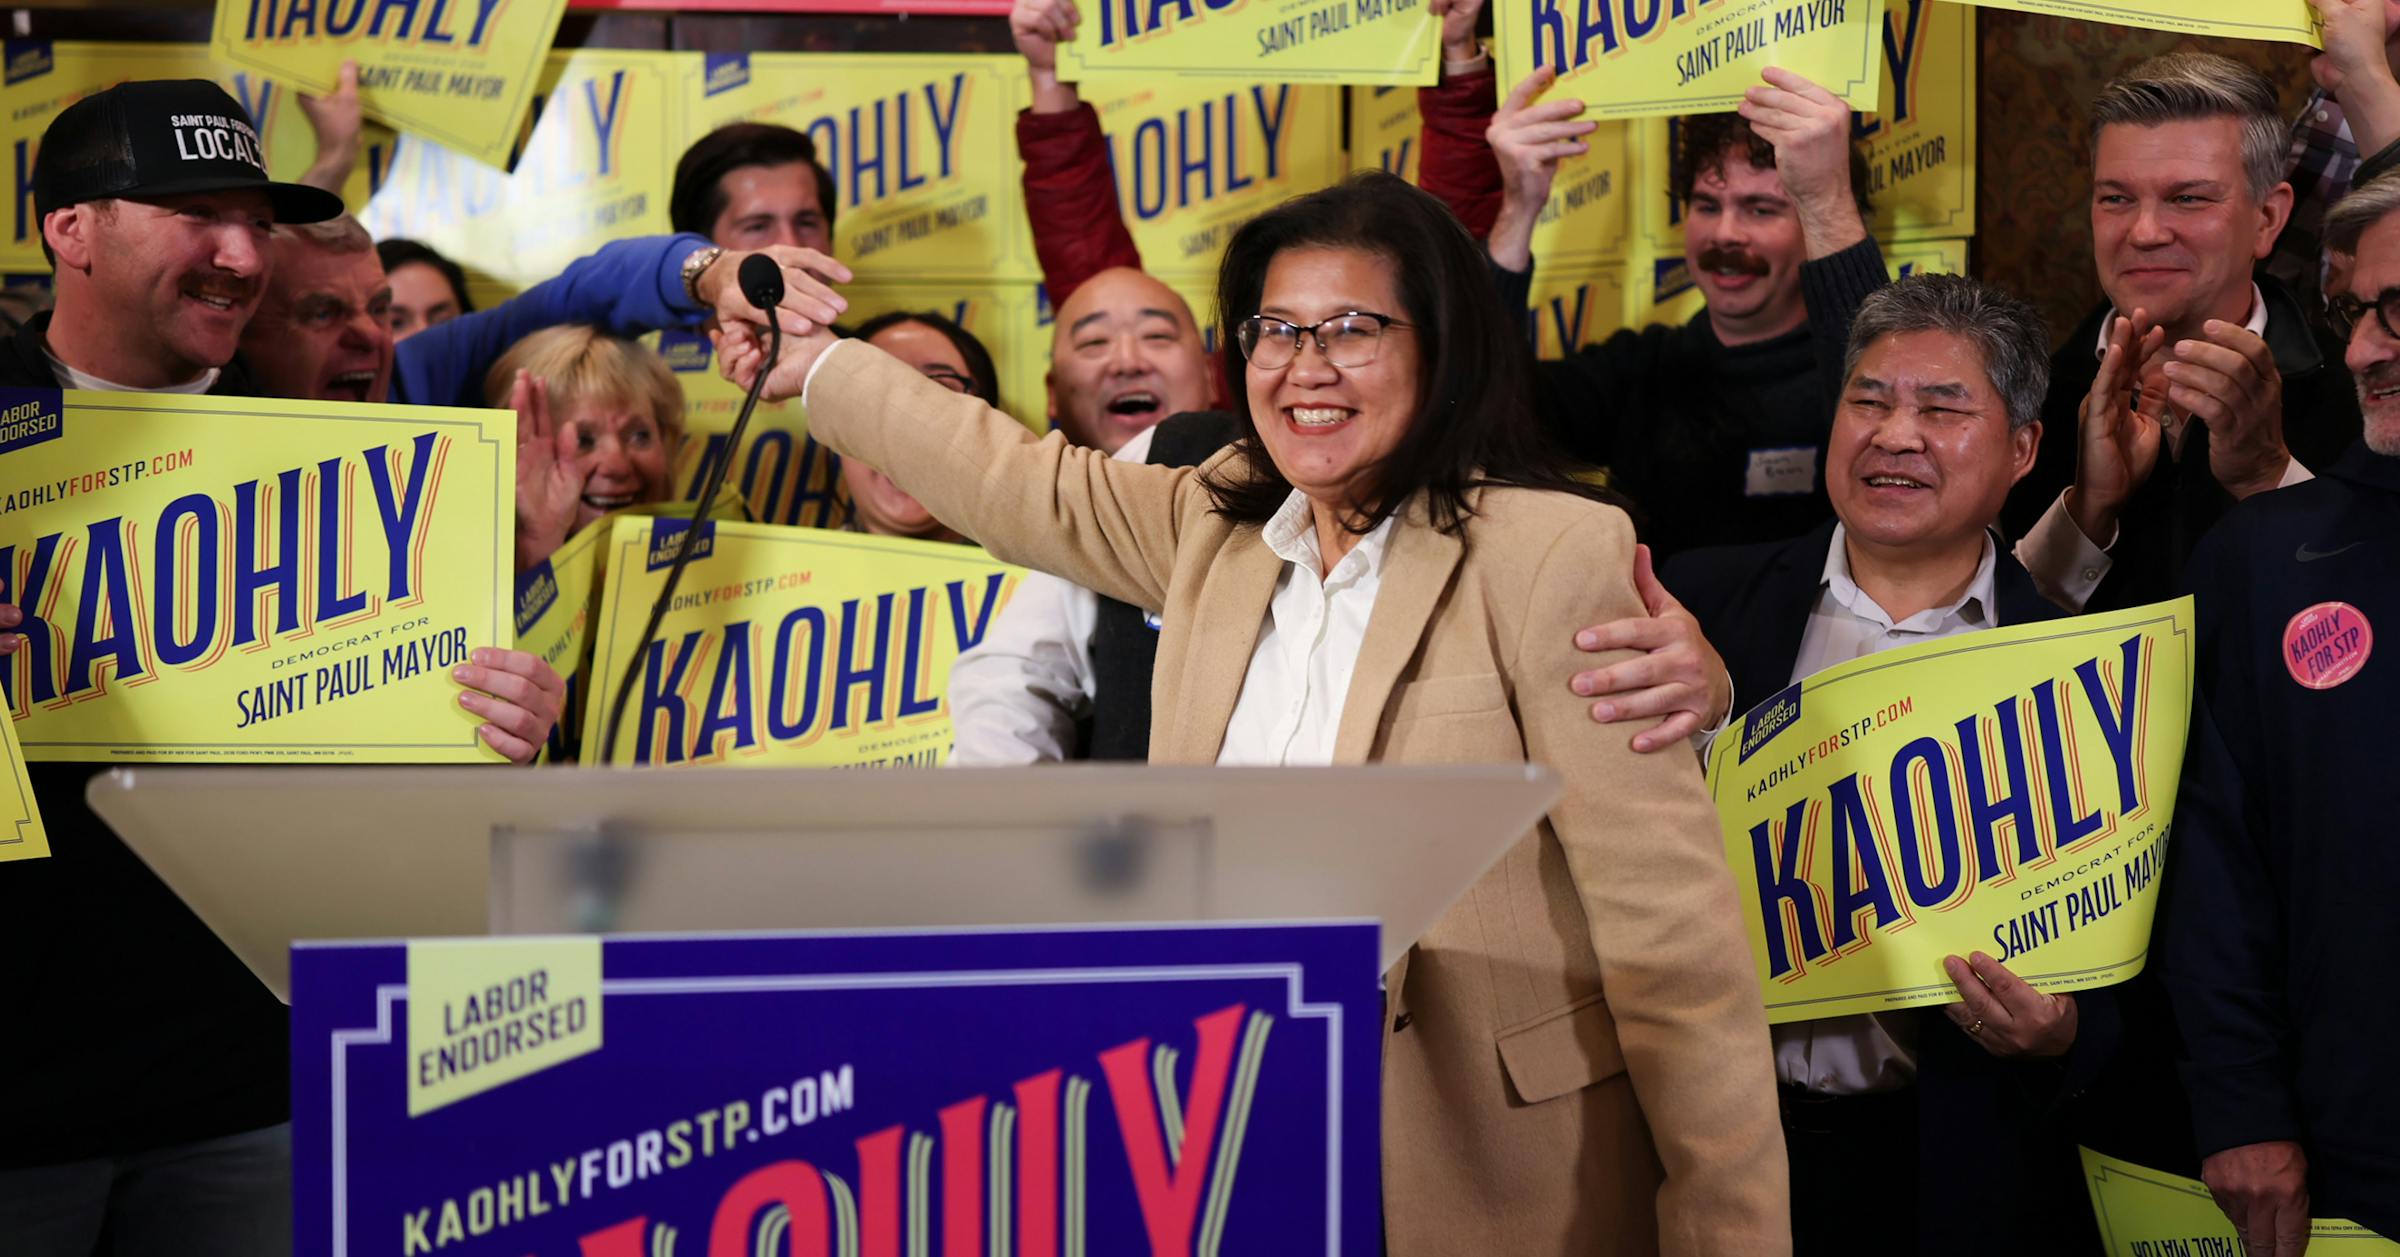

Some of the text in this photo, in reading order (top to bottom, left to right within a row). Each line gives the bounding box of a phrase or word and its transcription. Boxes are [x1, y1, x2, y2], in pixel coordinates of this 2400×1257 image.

[1257, 16, 1305, 57] SAINT
[1310, 3, 1351, 40] PAUL
[1676, 36, 1721, 87] SAINT
[1726, 17, 1767, 63] PAUL
[1774, 0, 1845, 42] MAYOR
[171, 114, 230, 129] SAINT PAUL
[806, 72, 965, 207] OHLY
[1105, 84, 1290, 222] OHLY
[1890, 135, 1946, 187] MAYOR
[0, 401, 40, 427] ABOR
[0, 413, 57, 444] DORSED
[0, 431, 440, 711] KAOHLY
[271, 616, 430, 670] DEMOCRAT FOR
[633, 573, 1006, 767] KAOHLY
[2291, 610, 2341, 664] KAOHLY
[2308, 645, 2335, 680] FOR
[2333, 626, 2359, 659] STP
[236, 626, 468, 729] SAINT PAUL MAYOR
[1741, 701, 1797, 756] ENDORSED
[1747, 695, 1914, 803] KAOHLYFORSTP.COM
[1751, 699, 1786, 735] LABOR
[1748, 632, 2143, 980] KAOHLY
[2020, 823, 2155, 901] DEMOCRAT FOR
[1993, 900, 2060, 964] SAINT
[2065, 872, 2122, 933] PAUL
[442, 968, 551, 1038] LABOR
[418, 996, 588, 1089] ENDORSED
[402, 1063, 855, 1257] KAOHLYFORSTP.COM
